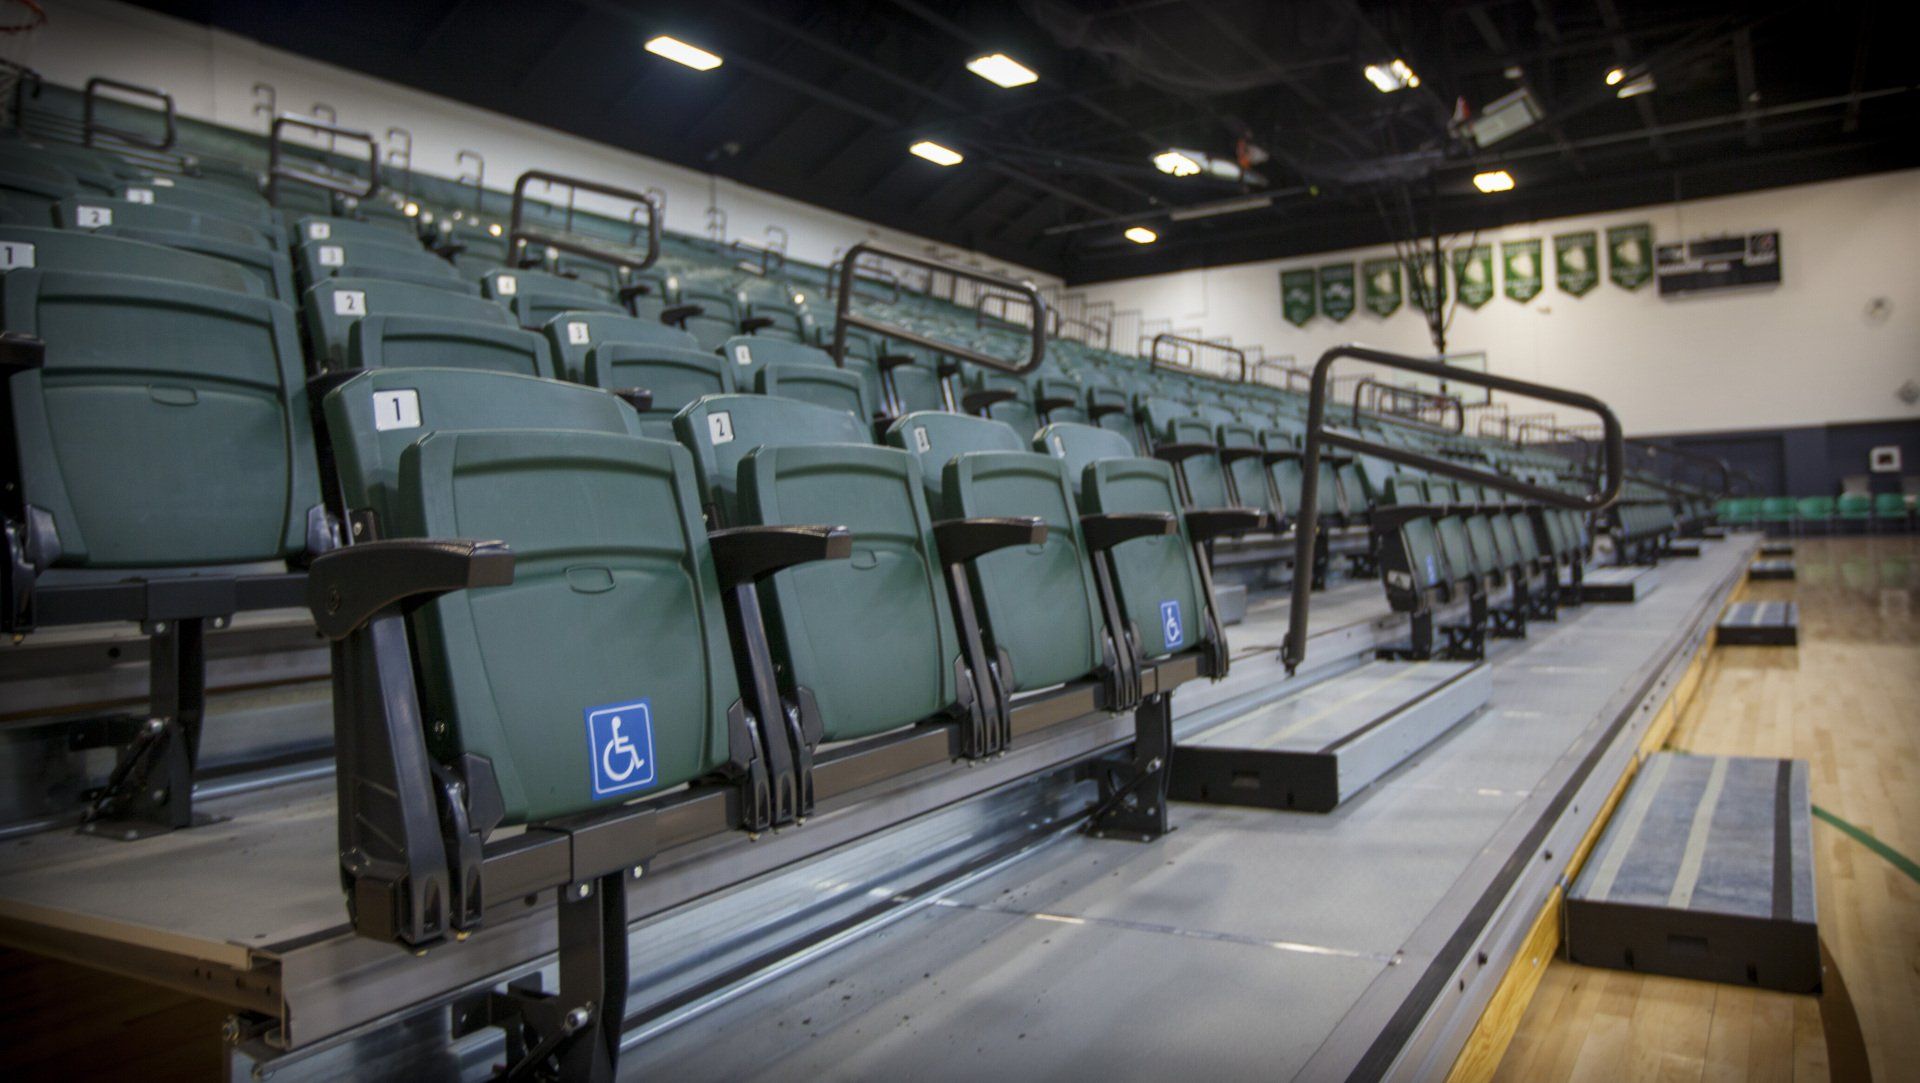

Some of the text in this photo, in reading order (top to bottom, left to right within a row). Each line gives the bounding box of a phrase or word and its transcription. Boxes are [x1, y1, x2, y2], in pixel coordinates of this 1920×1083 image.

[91, 210, 100, 224] 2
[4, 246, 13, 264] 1
[346, 295, 355, 310] 2
[392, 398, 401, 421] 1
[716, 418, 725, 437] 2
